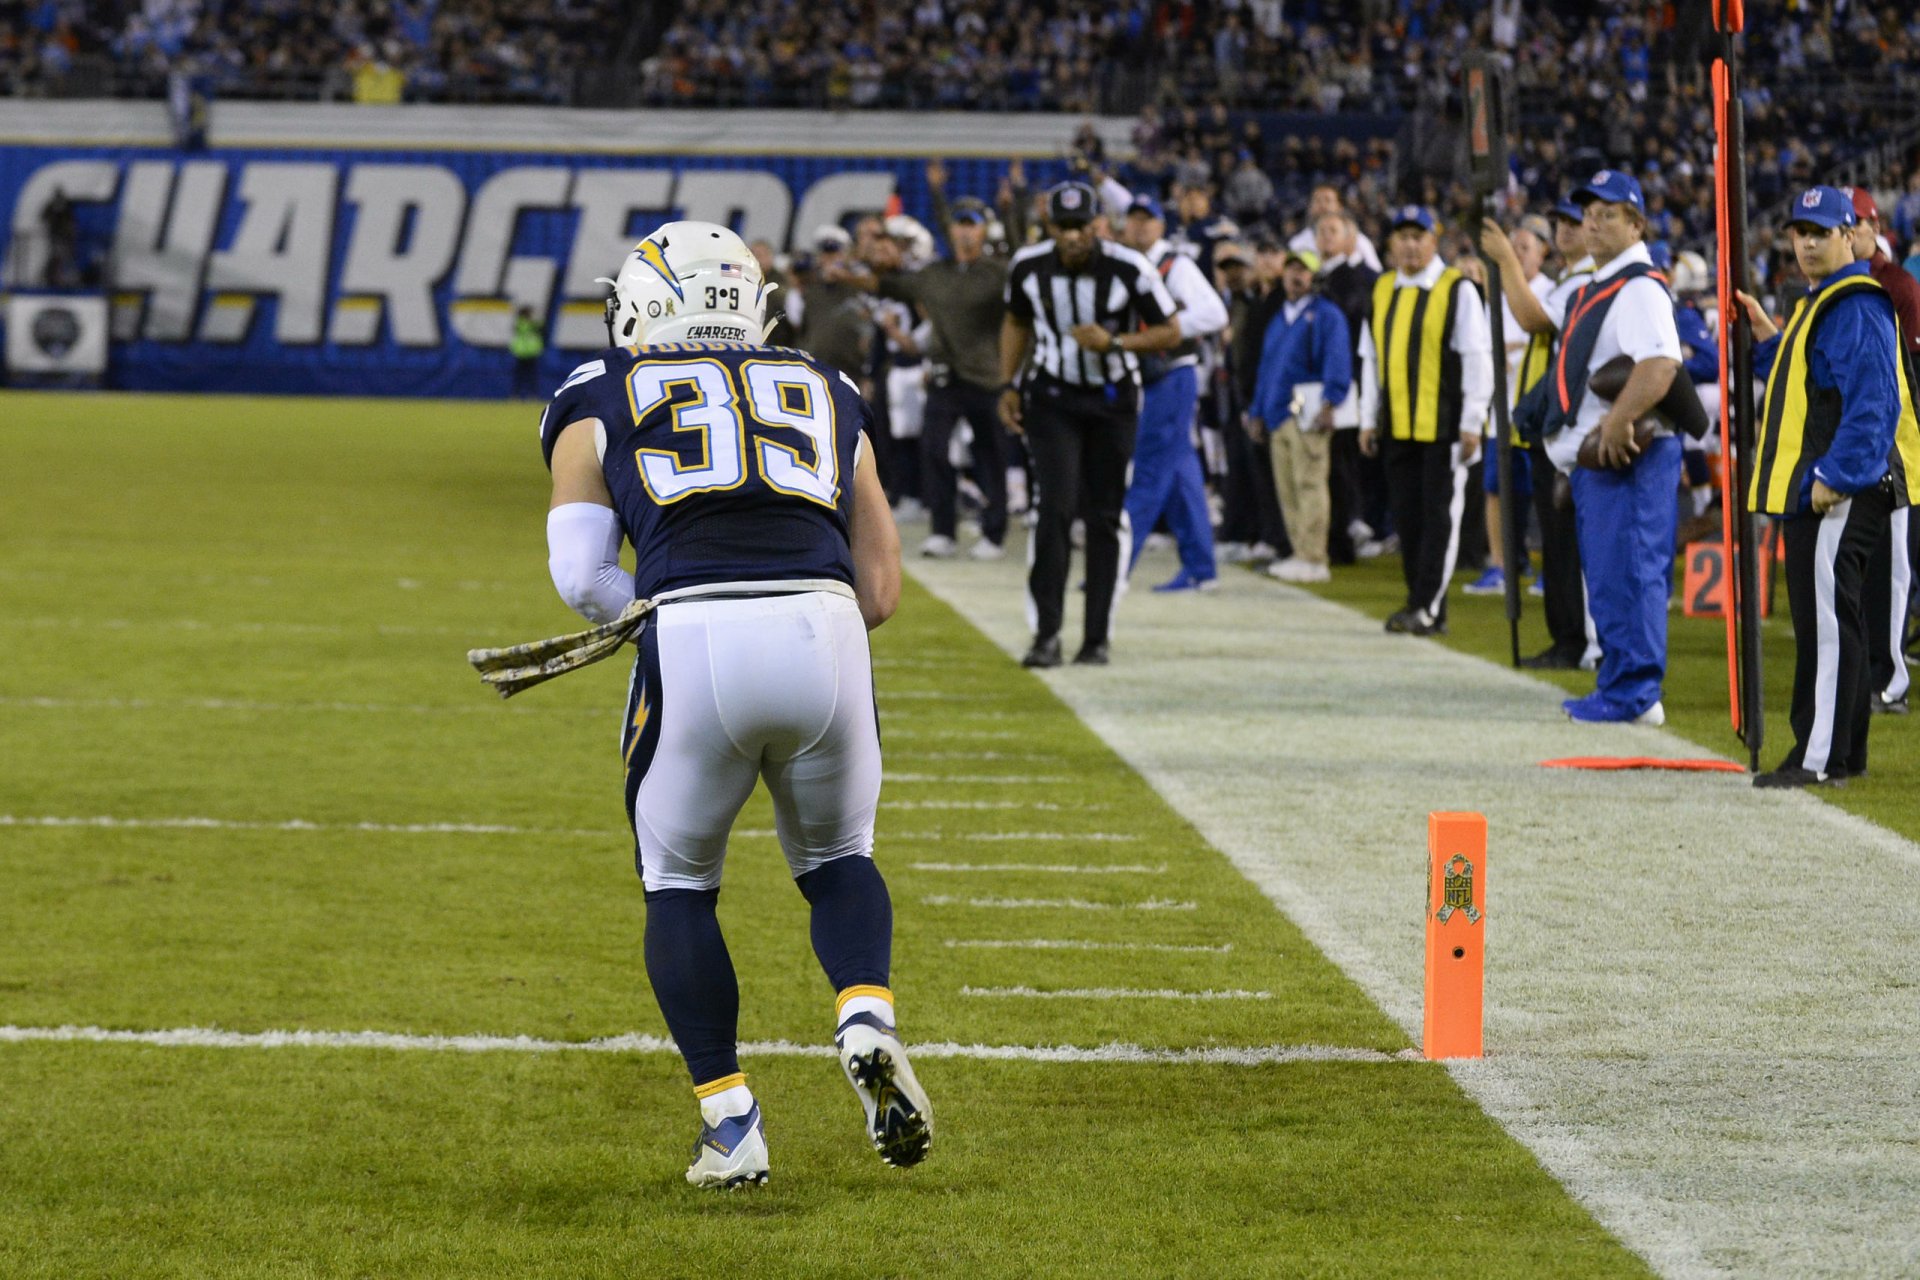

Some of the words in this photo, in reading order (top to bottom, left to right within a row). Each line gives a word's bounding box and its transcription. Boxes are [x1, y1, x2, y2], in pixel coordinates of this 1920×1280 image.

[687, 325, 747, 341] CHARGERS
[626, 357, 842, 510] 39
[1447, 889, 1470, 904] NFL
